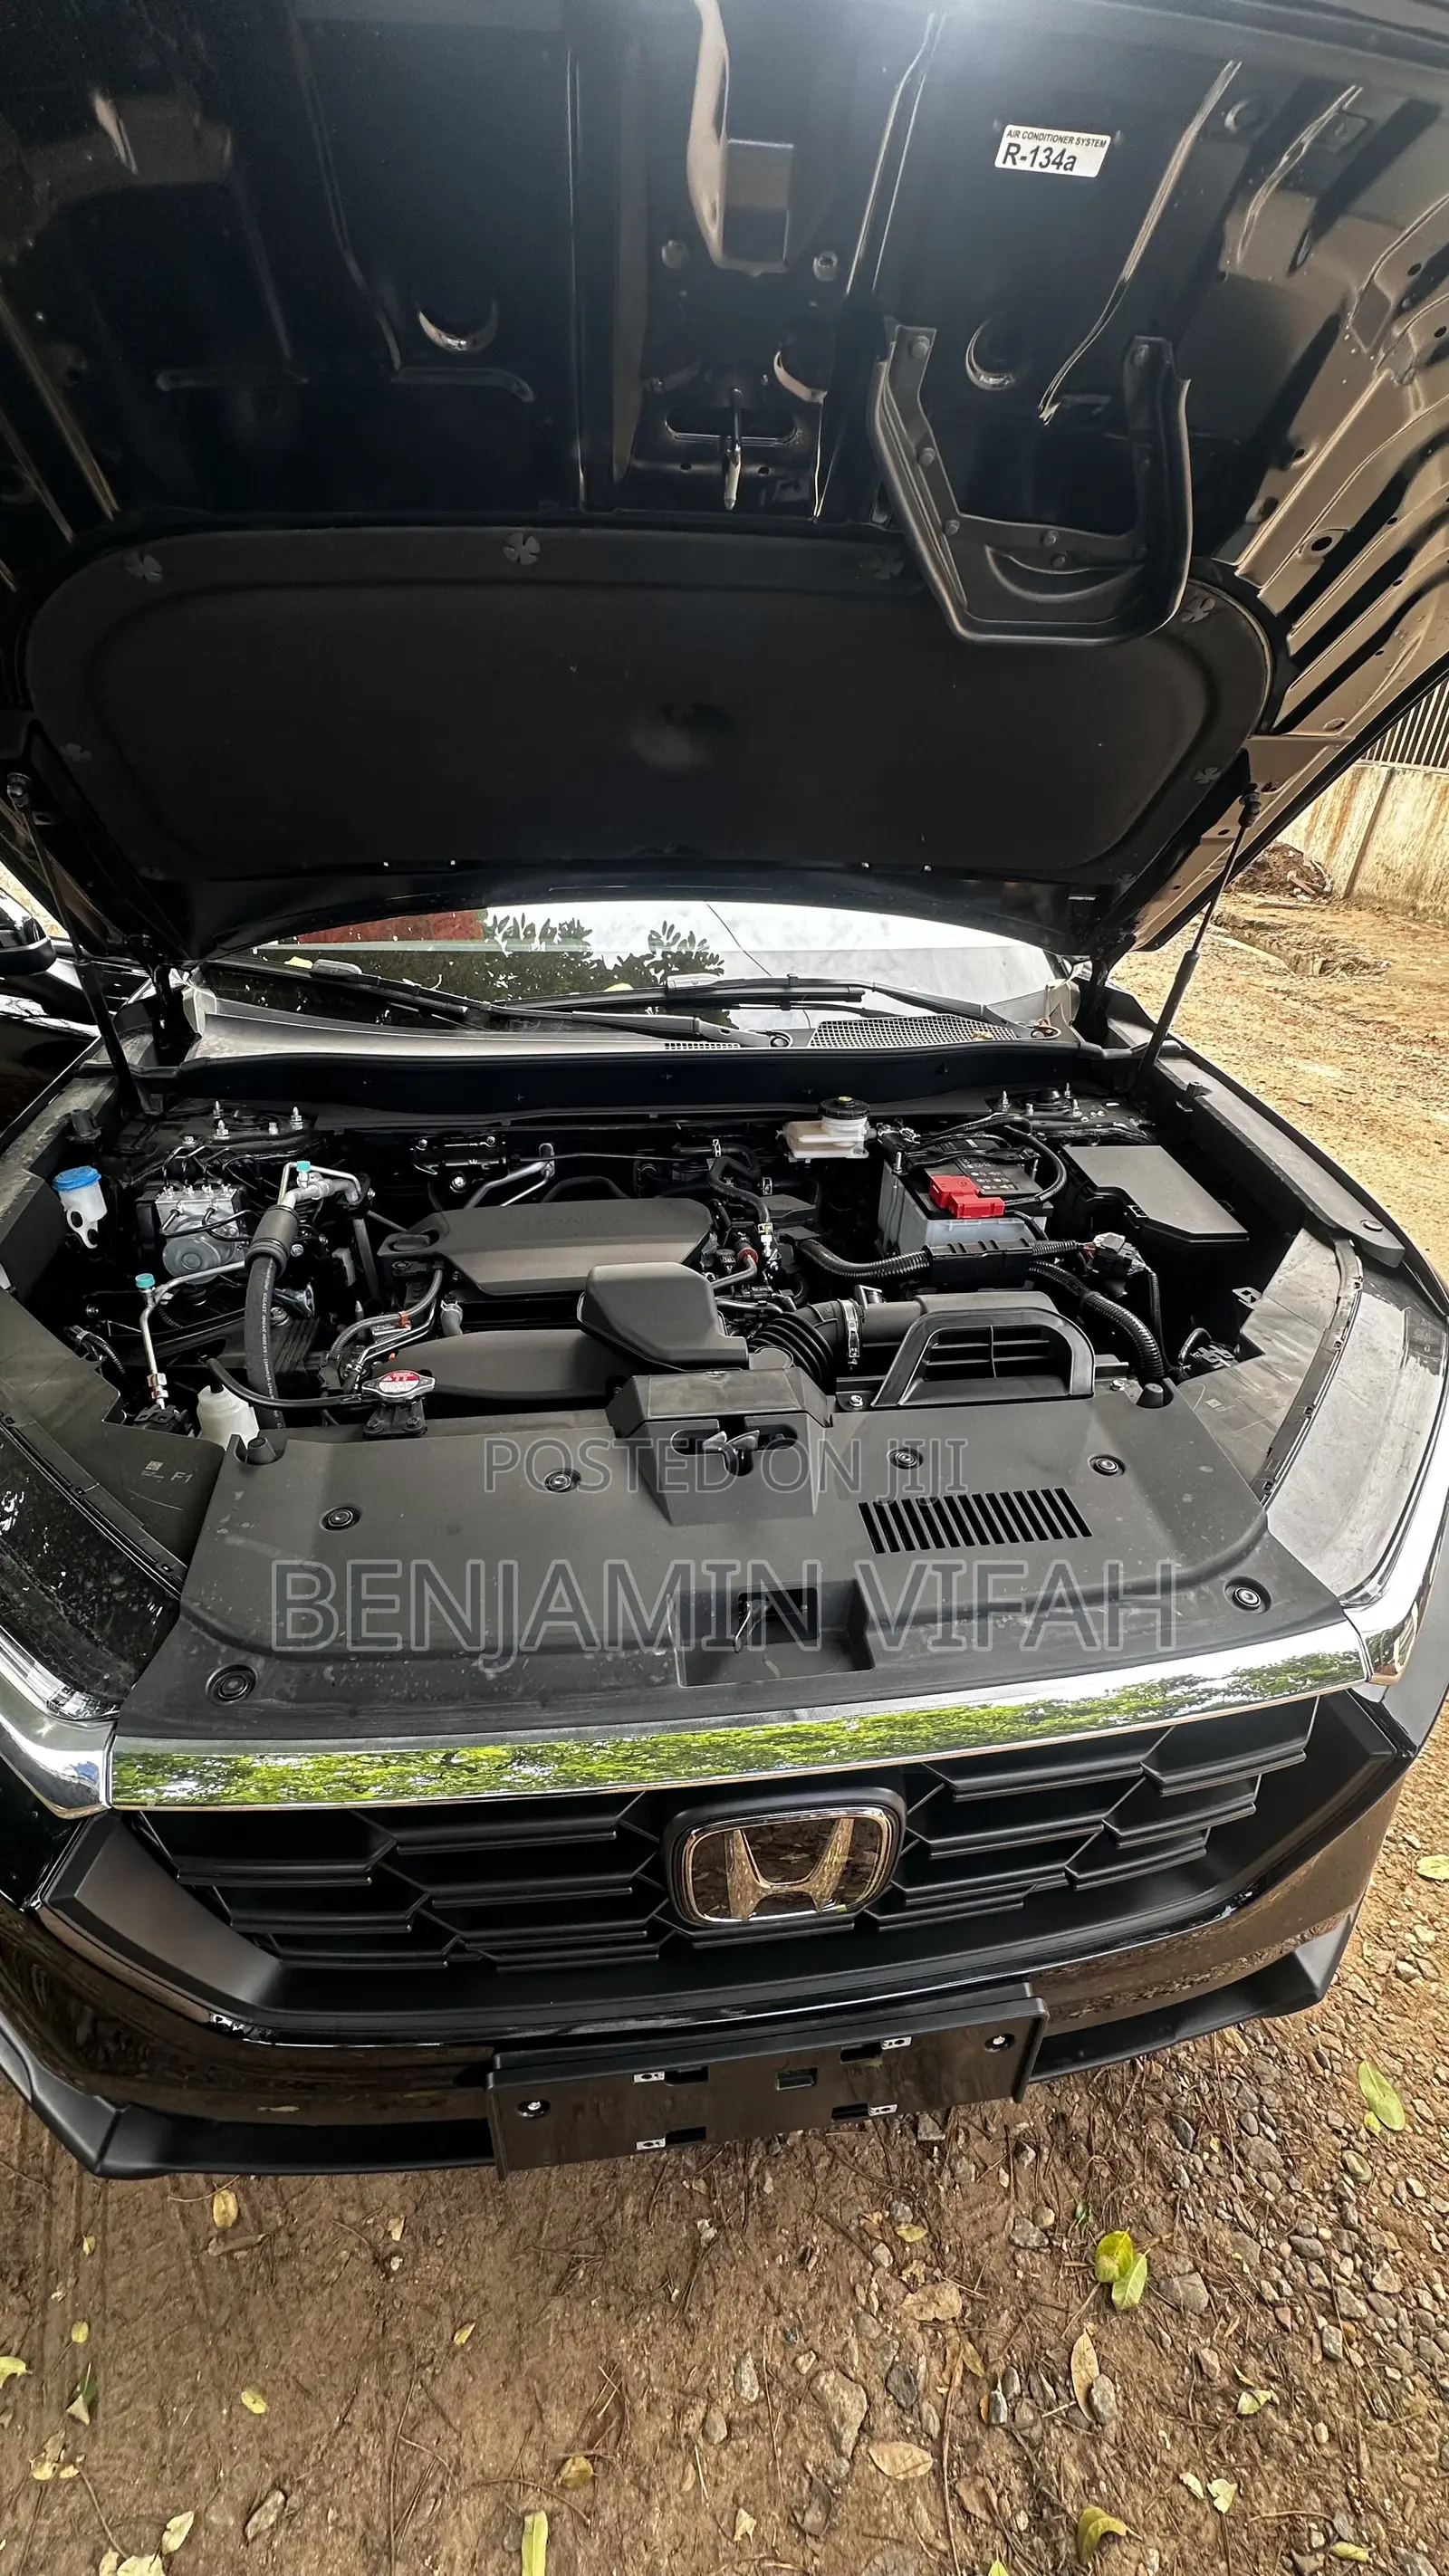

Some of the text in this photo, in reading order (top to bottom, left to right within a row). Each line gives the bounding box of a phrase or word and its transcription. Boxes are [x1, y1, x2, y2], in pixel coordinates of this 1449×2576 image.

[1006, 129, 1108, 148] AIR CONDITIONER SYSTEM
[1002, 142, 1078, 172] R-134a
[170, 1470, 194, 1483] F1
